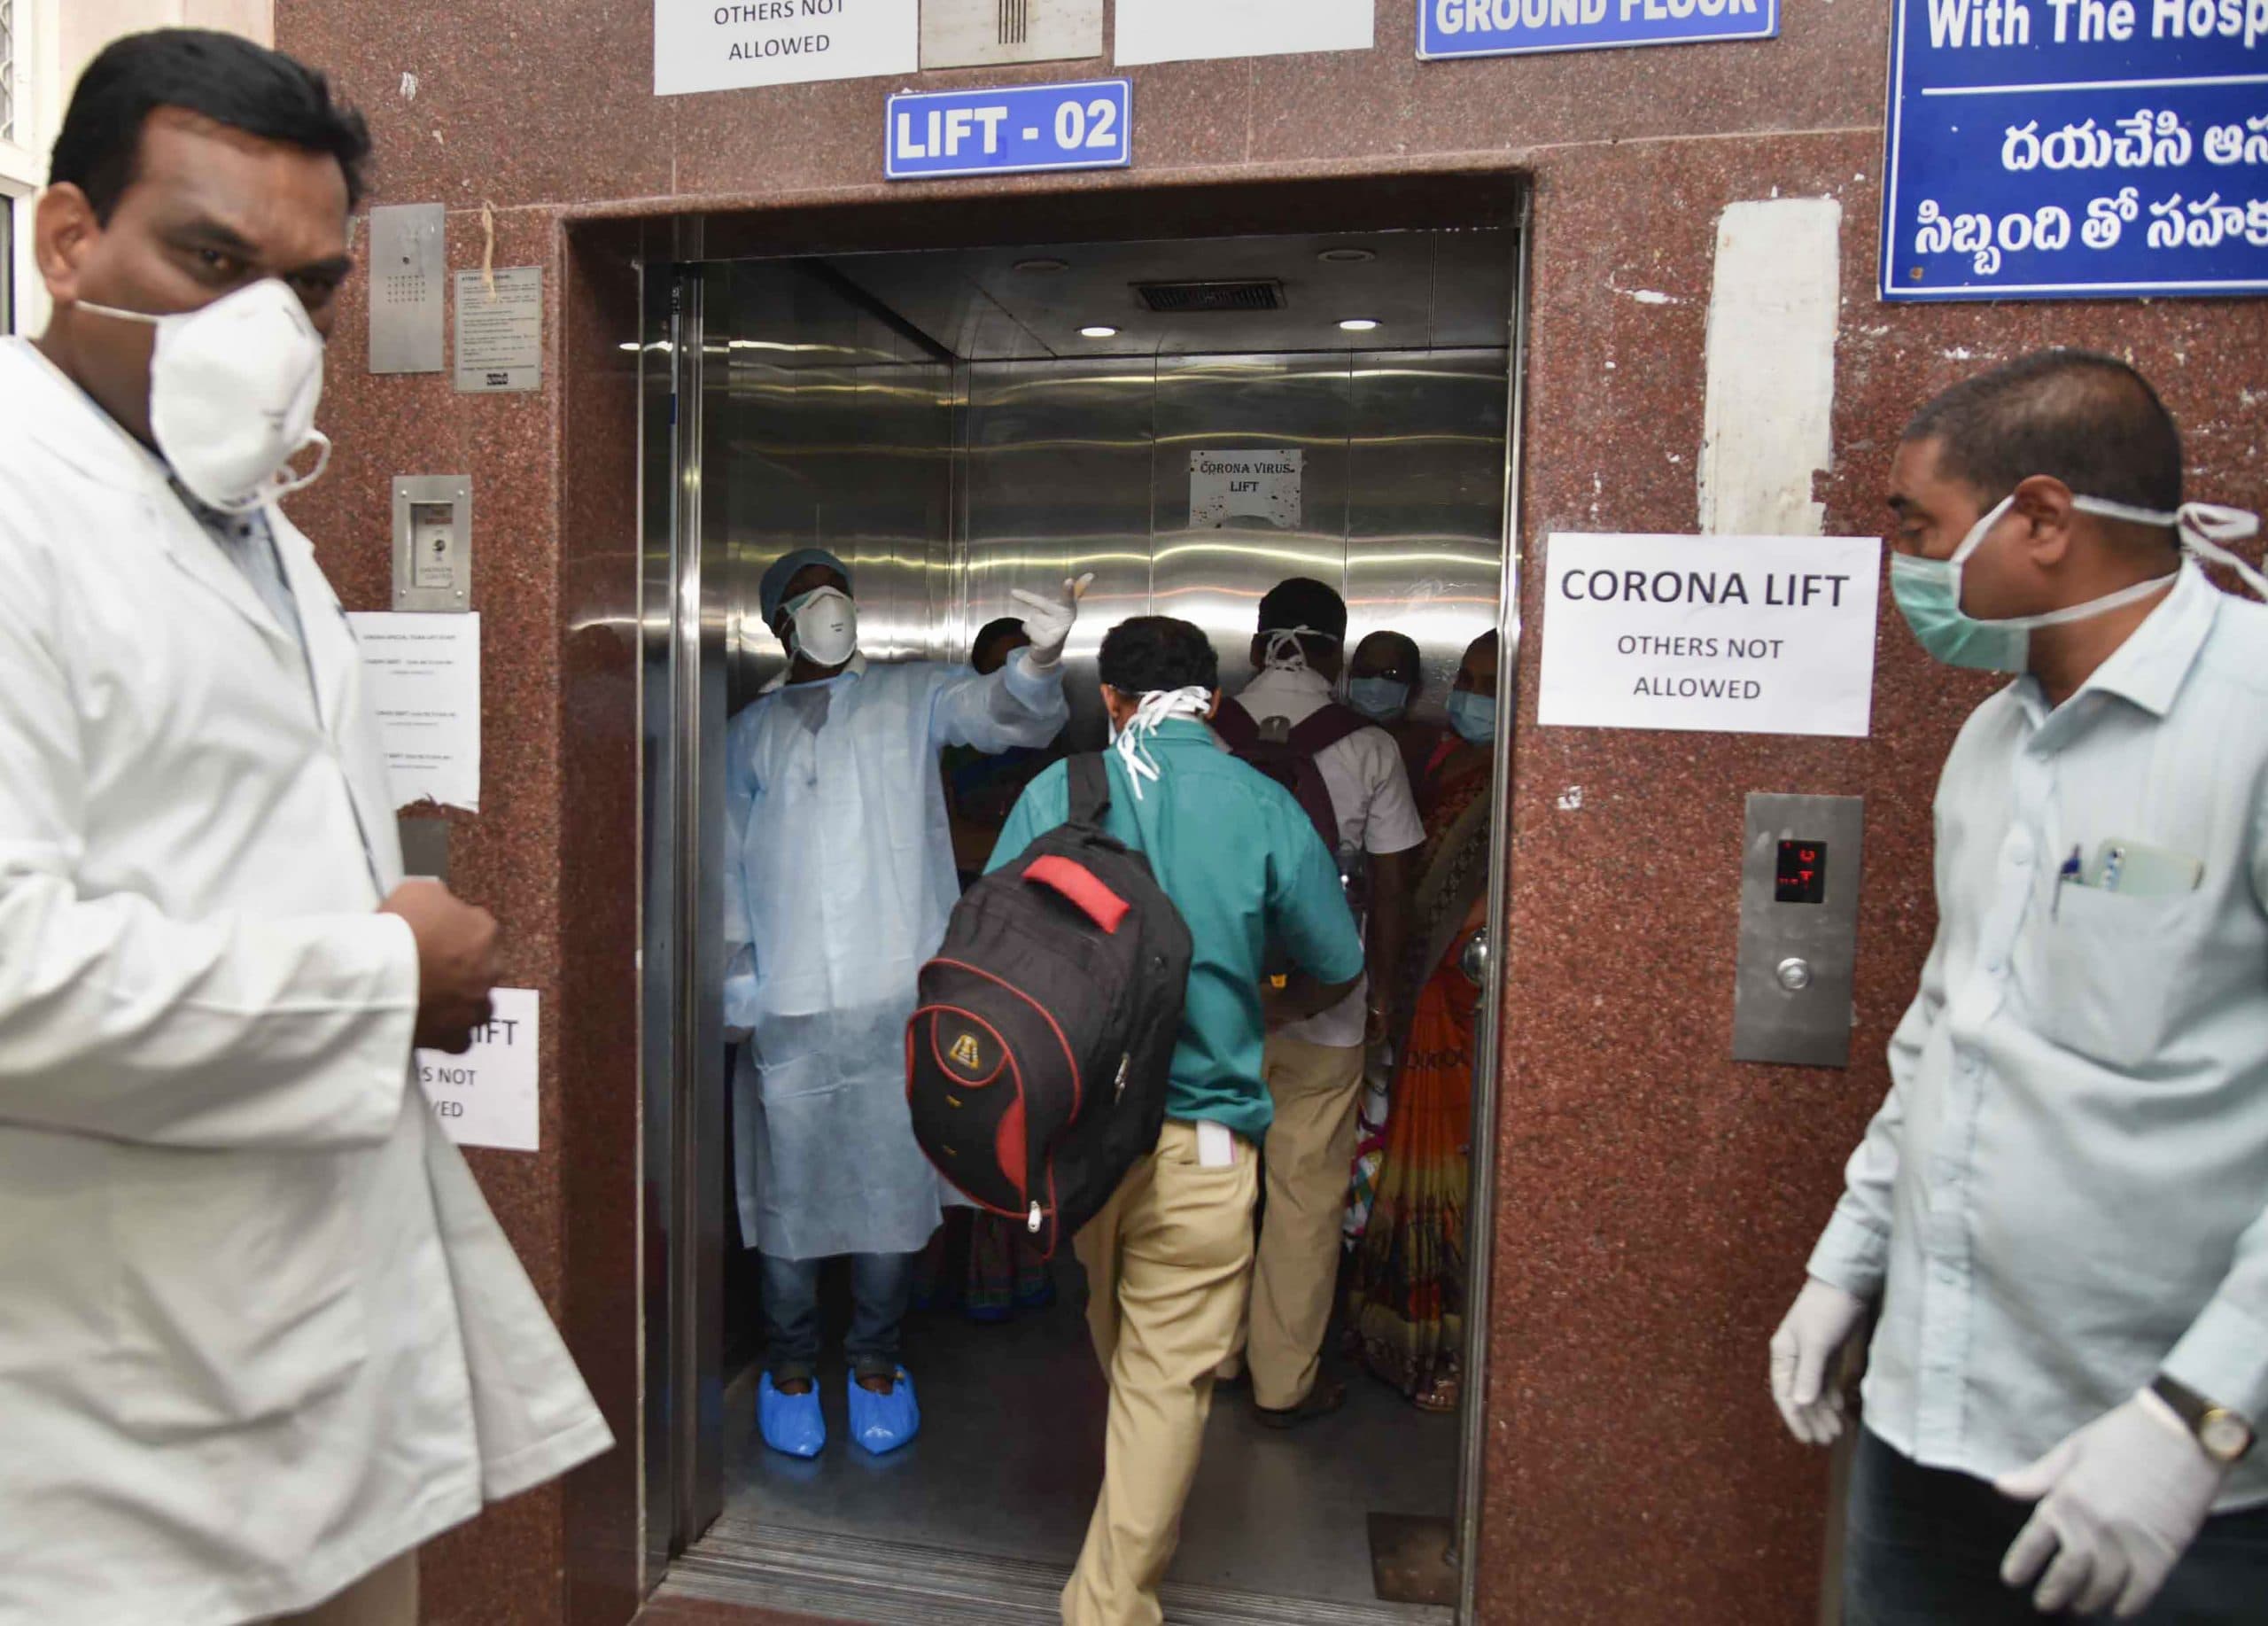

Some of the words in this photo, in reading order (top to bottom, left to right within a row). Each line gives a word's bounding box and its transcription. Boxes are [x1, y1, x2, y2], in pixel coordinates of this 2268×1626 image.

[714, 1, 794, 25] OTHERS
[1927, 0, 2030, 48] With
[2047, 0, 2135, 43] The
[728, 35, 829, 60] ALLOWED
[897, 105, 1007, 159] LIFT
[1021, 127, 1038, 140] -
[1054, 99, 1117, 149] 02
[2001, 109, 2192, 171] దయచేసి
[1915, 199, 2071, 275] సిబ్బంది
[1200, 463, 1250, 475] CORONA
[1230, 481, 1259, 493] LIFT
[1562, 569, 1750, 605] CORONA
[1766, 572, 1850, 607] LIFT
[1618, 634, 1718, 657] OTHERS
[1727, 638, 1784, 659] NOT
[1633, 676, 1762, 700] ALLOWED
[477, 1020, 518, 1045] IFT
[439, 1067, 477, 1085] NOT
